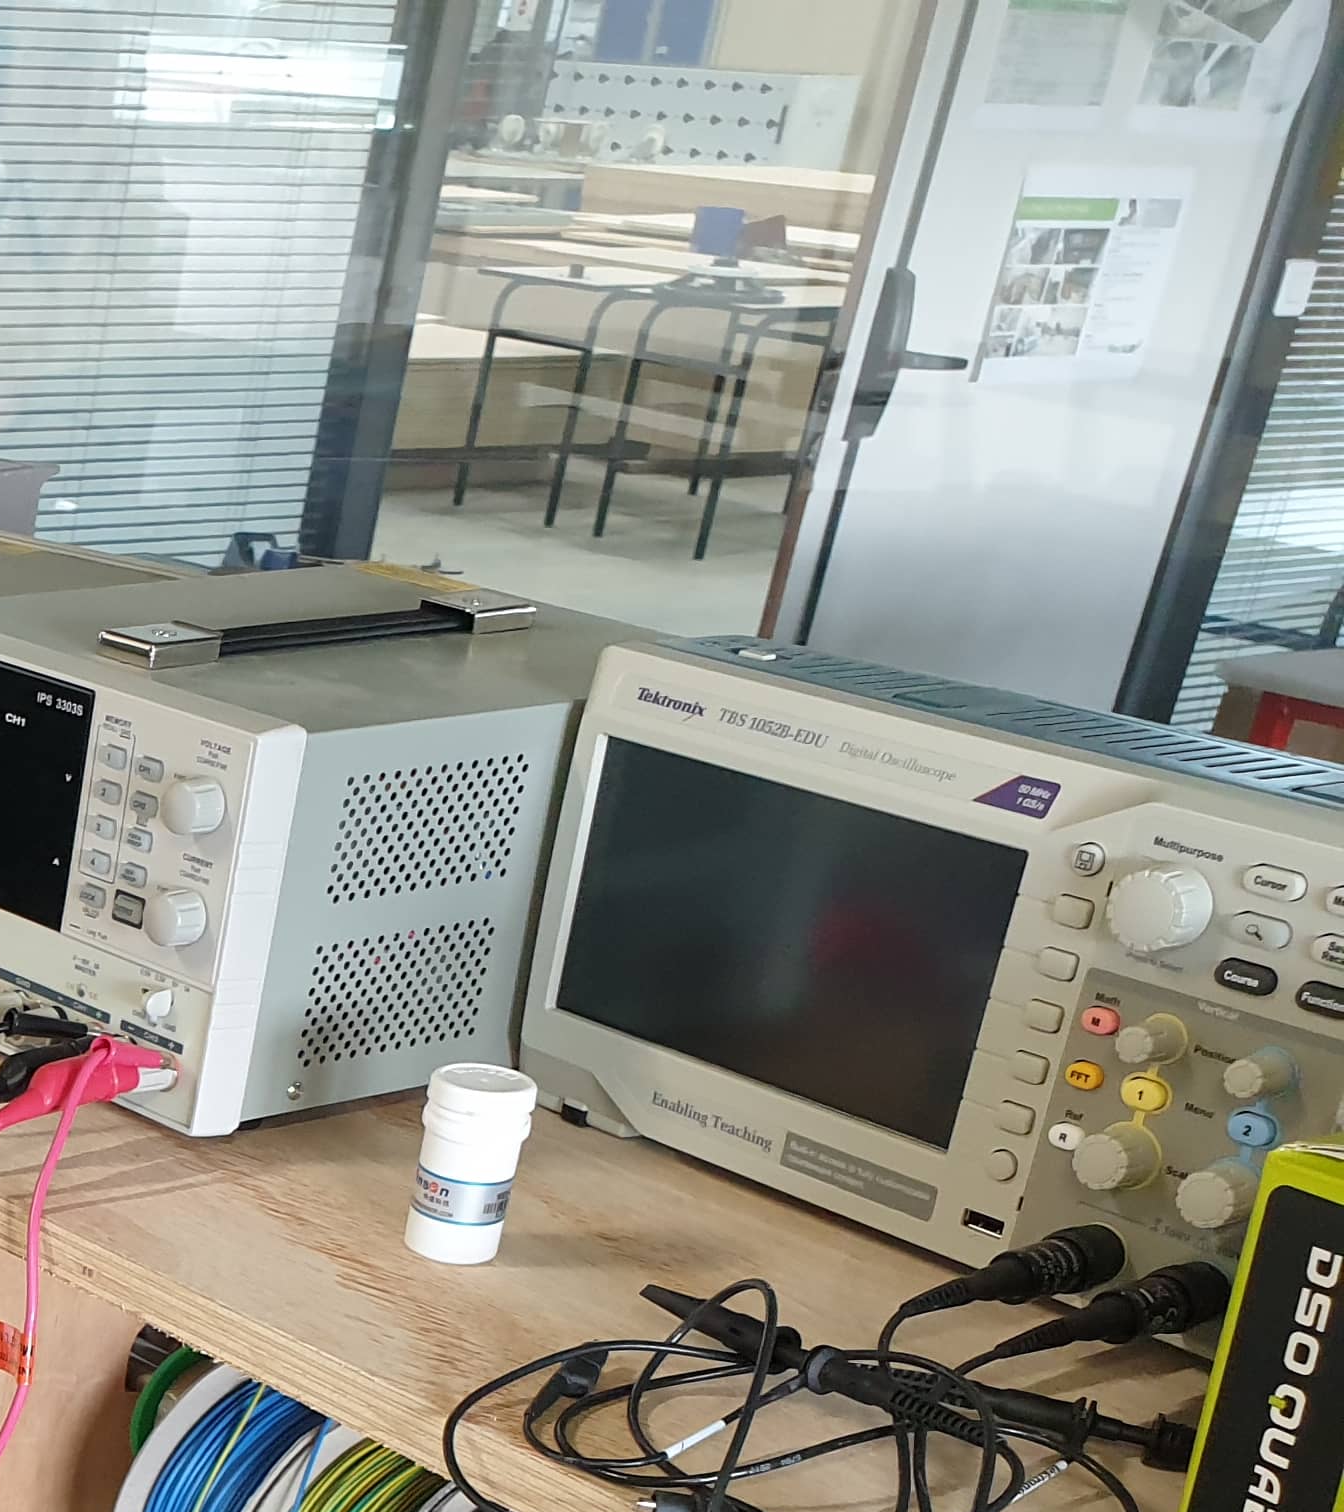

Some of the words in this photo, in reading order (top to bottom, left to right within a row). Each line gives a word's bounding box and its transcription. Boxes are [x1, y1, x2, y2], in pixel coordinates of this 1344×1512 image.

[36, 691, 53, 707] IPS
[55, 698, 84, 717] 3303S
[5, 712, 27, 728] CH1
[636, 686, 708, 723] Tektronix
[718, 706, 747, 728] TBS
[748, 715, 831, 750] 1052B-EDU
[838, 740, 879, 763] Digital
[880, 751, 958, 783] Oscilloscope
[1153, 835, 1224, 863] Multipurpose
[1253, 874, 1288, 892] Cursor
[1223, 969, 1260, 989] Course
[1095, 991, 1121, 1006] Math
[1198, 1000, 1240, 1020] Vertical
[1090, 1016, 1101, 1027] M
[1069, 1070, 1091, 1084] FFT
[1064, 1108, 1085, 1121] Ref
[1184, 1101, 1216, 1120] Menu
[651, 1090, 710, 1129] Enabling
[711, 1114, 774, 1153] Teaching
[1242, 1125, 1252, 1138] 2
[1165, 1164, 1190, 1181] Scal
[1283, 1245, 1344, 1377] DSO
